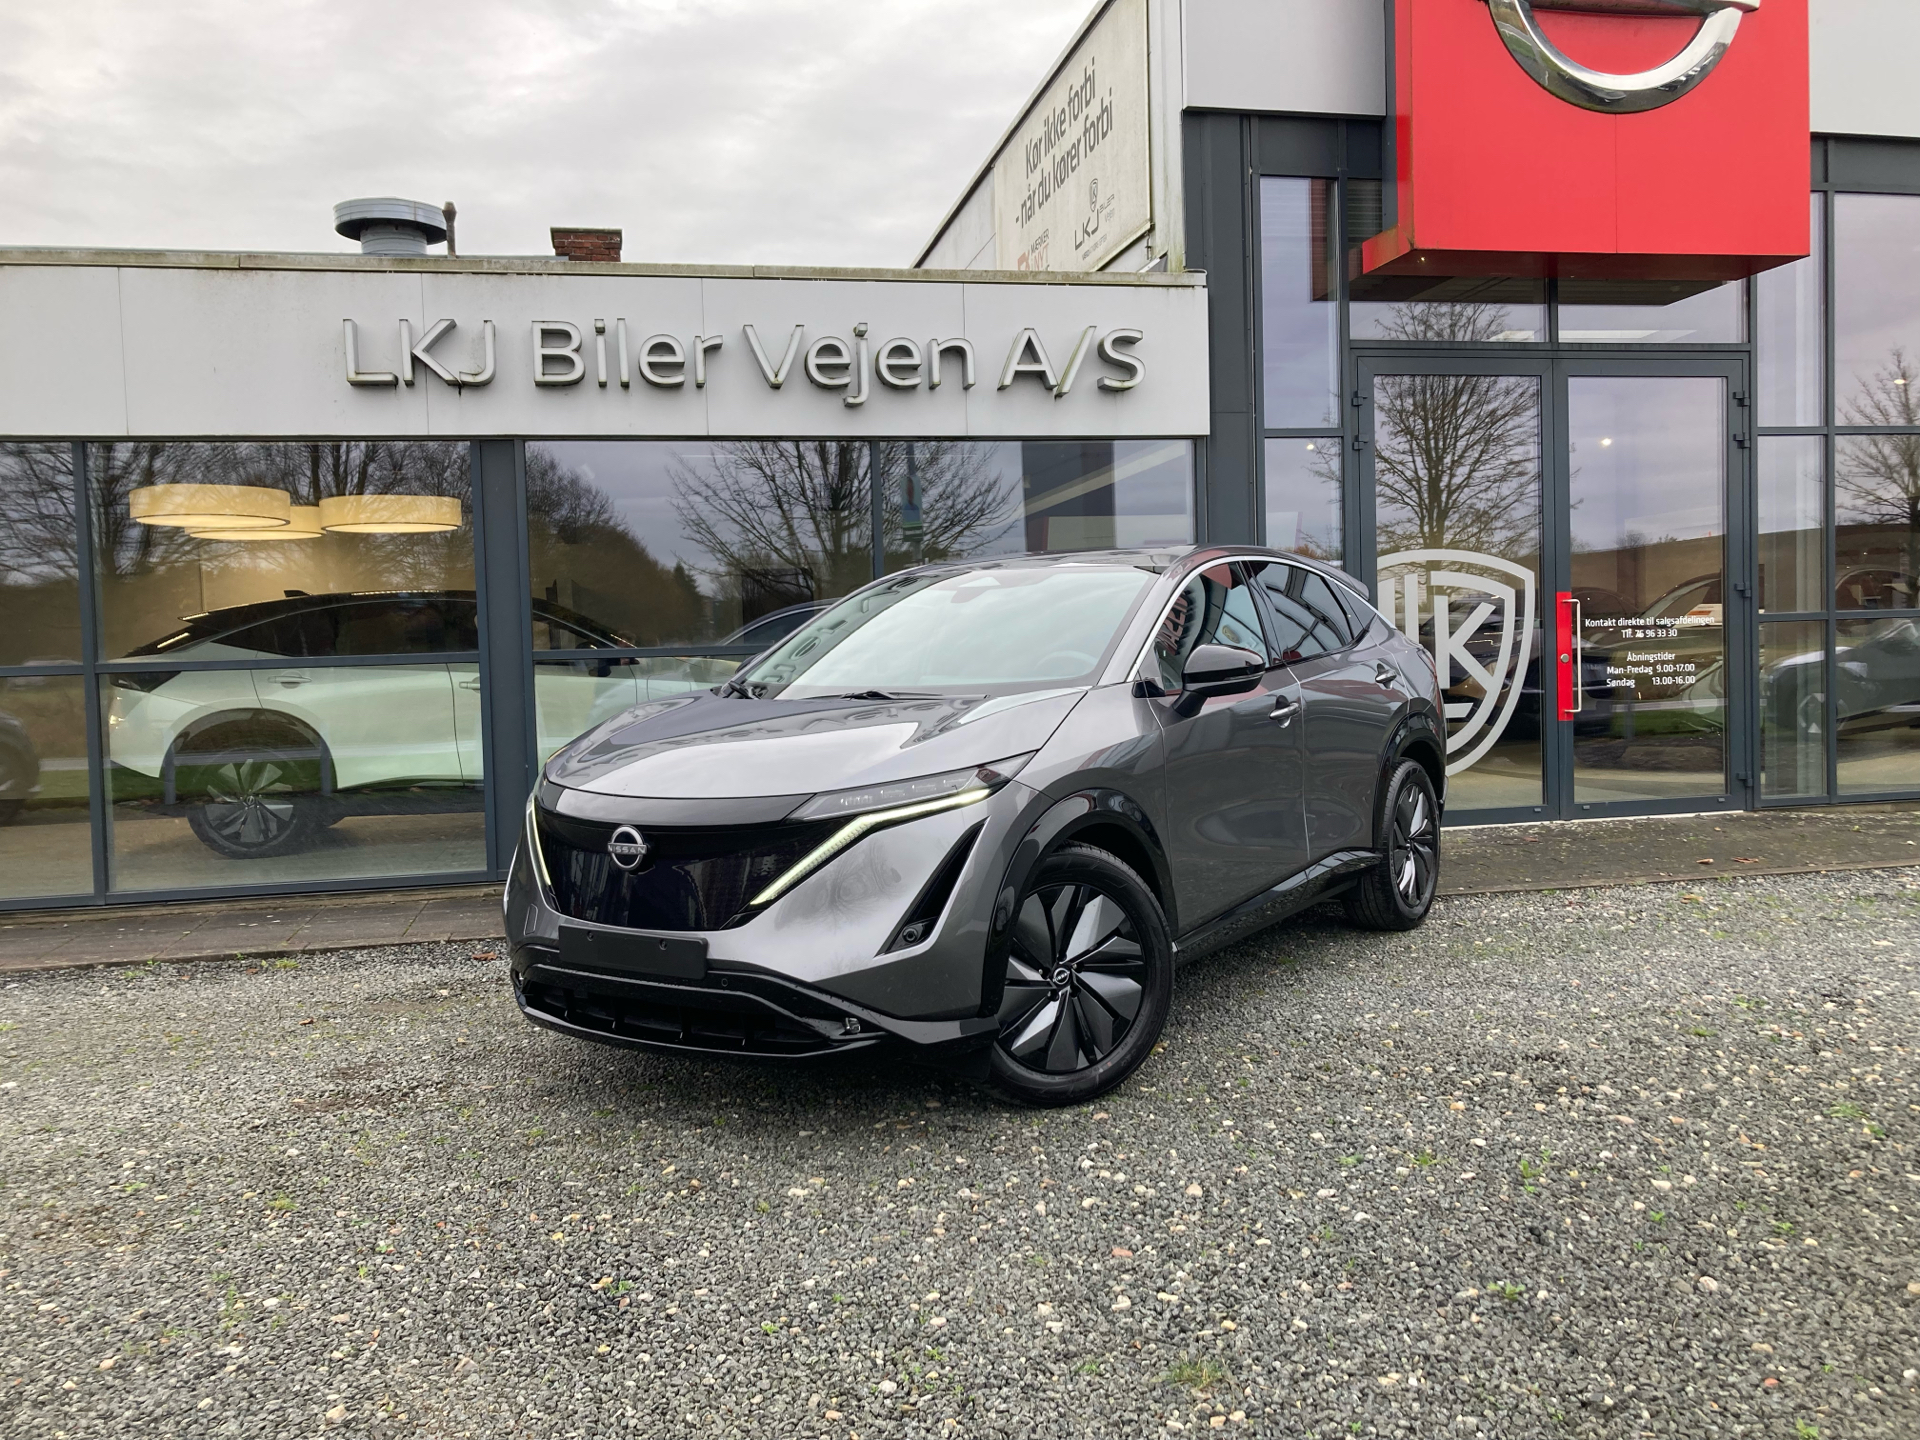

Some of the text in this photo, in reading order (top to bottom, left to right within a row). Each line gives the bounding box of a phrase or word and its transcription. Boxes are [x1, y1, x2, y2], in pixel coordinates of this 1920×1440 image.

[1025, 56, 1096, 180] Kør ikke forbi
[1021, 183, 1036, 229] når
[1037, 168, 1051, 210] du
[1052, 135, 1082, 193] kører
[1082, 87, 1113, 160] forbi
[1074, 208, 1100, 251] LKJ
[342, 316, 1148, 408] LKJ Biler Vejen A/S
[1585, 615, 1715, 628] Kontakt direkte til salgsafdelingen
[1645, 629, 1656, 638] 96
[1656, 628, 1667, 638] 33
[1667, 628, 1678, 637] 30
[1626, 651, 1676, 663] Åbningstider
[1606, 663, 1695, 675] Man-Fredag 9.00-17.00
[1606, 675, 1696, 688] Søndag 13.00-16.00
[608, 844, 646, 855] NISSAN
